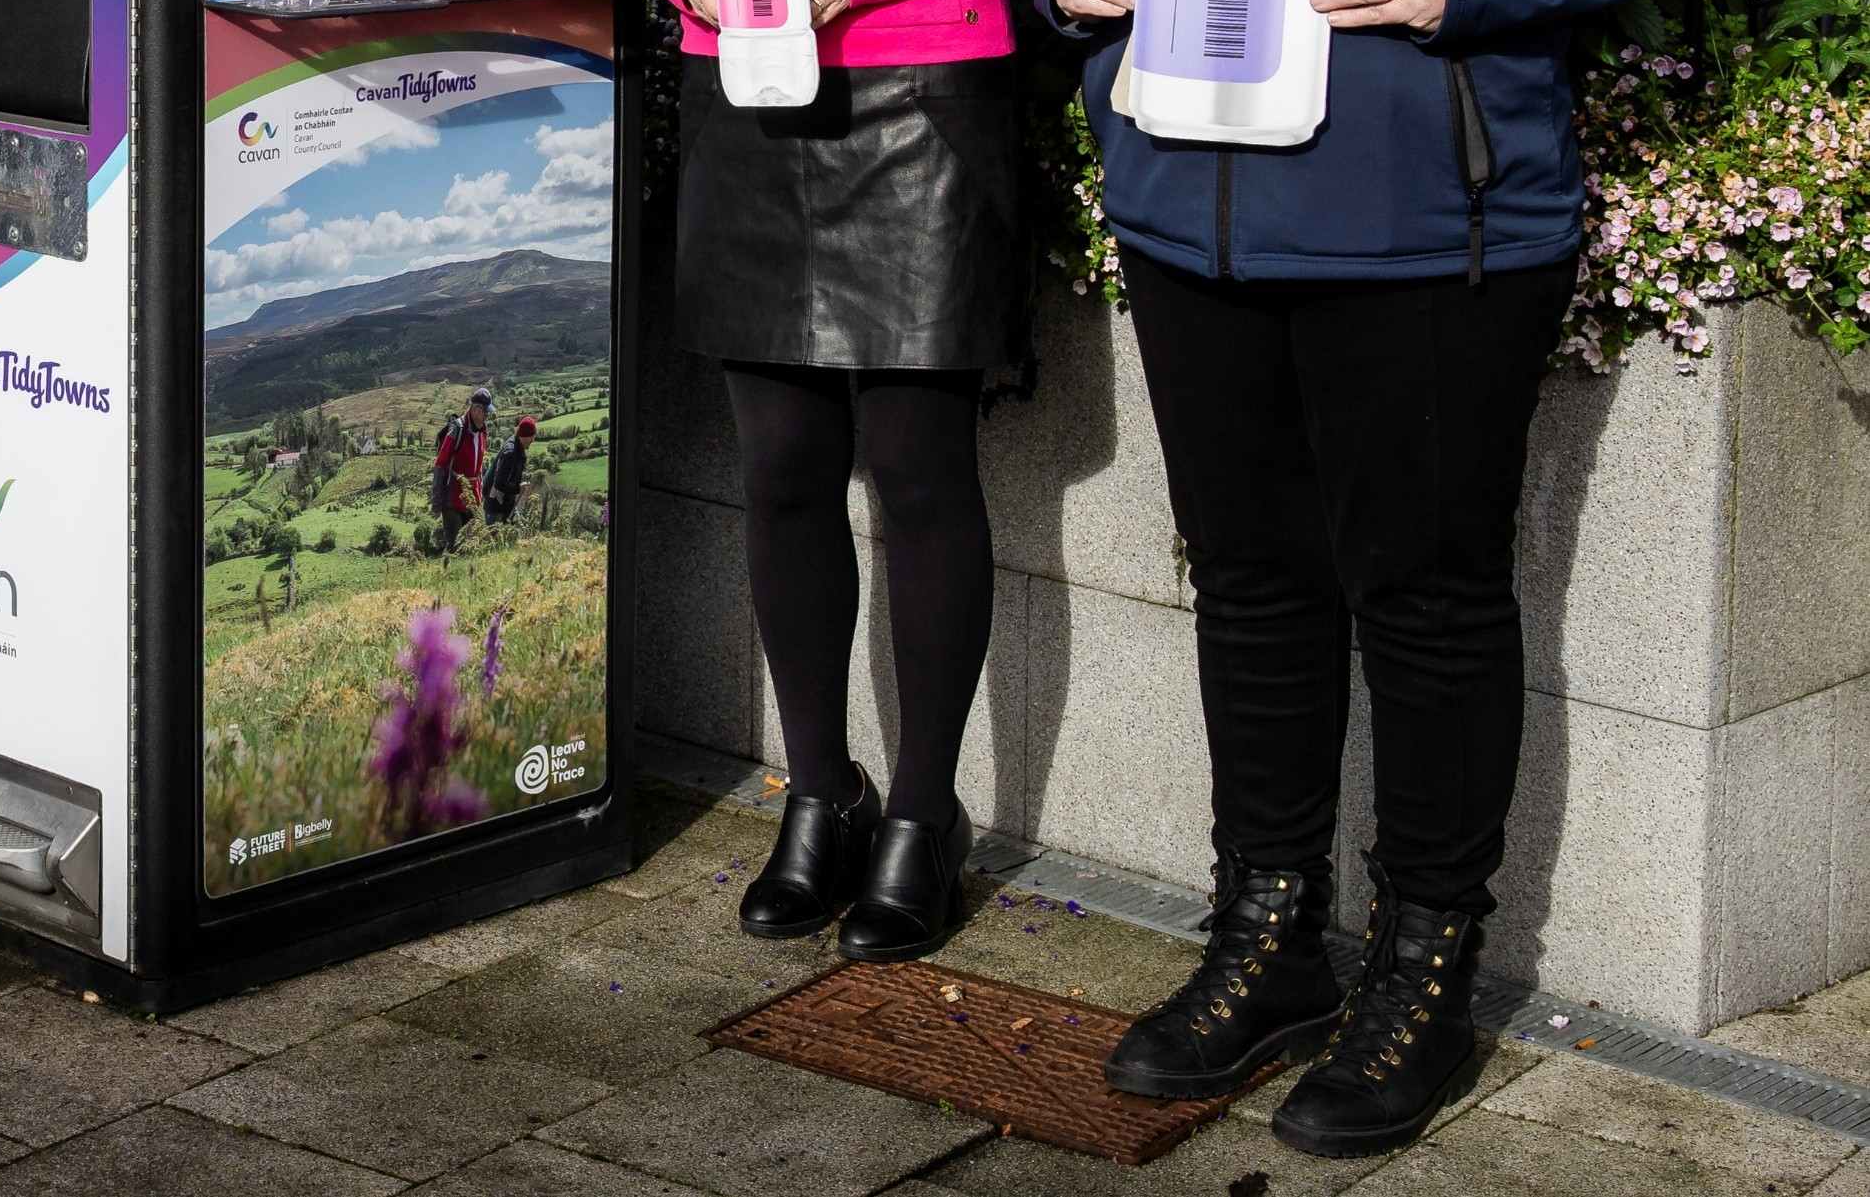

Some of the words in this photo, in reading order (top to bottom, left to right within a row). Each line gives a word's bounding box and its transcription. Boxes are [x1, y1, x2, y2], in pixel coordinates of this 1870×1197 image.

[294, 109, 329, 120] Comhairle
[551, 740, 586, 758] Leave
[551, 757, 568, 772] No
[551, 766, 585, 784] Trace
[250, 829, 286, 847] FUTURE
[294, 818, 333, 840] Bigbelly
[250, 839, 286, 857] STREET
